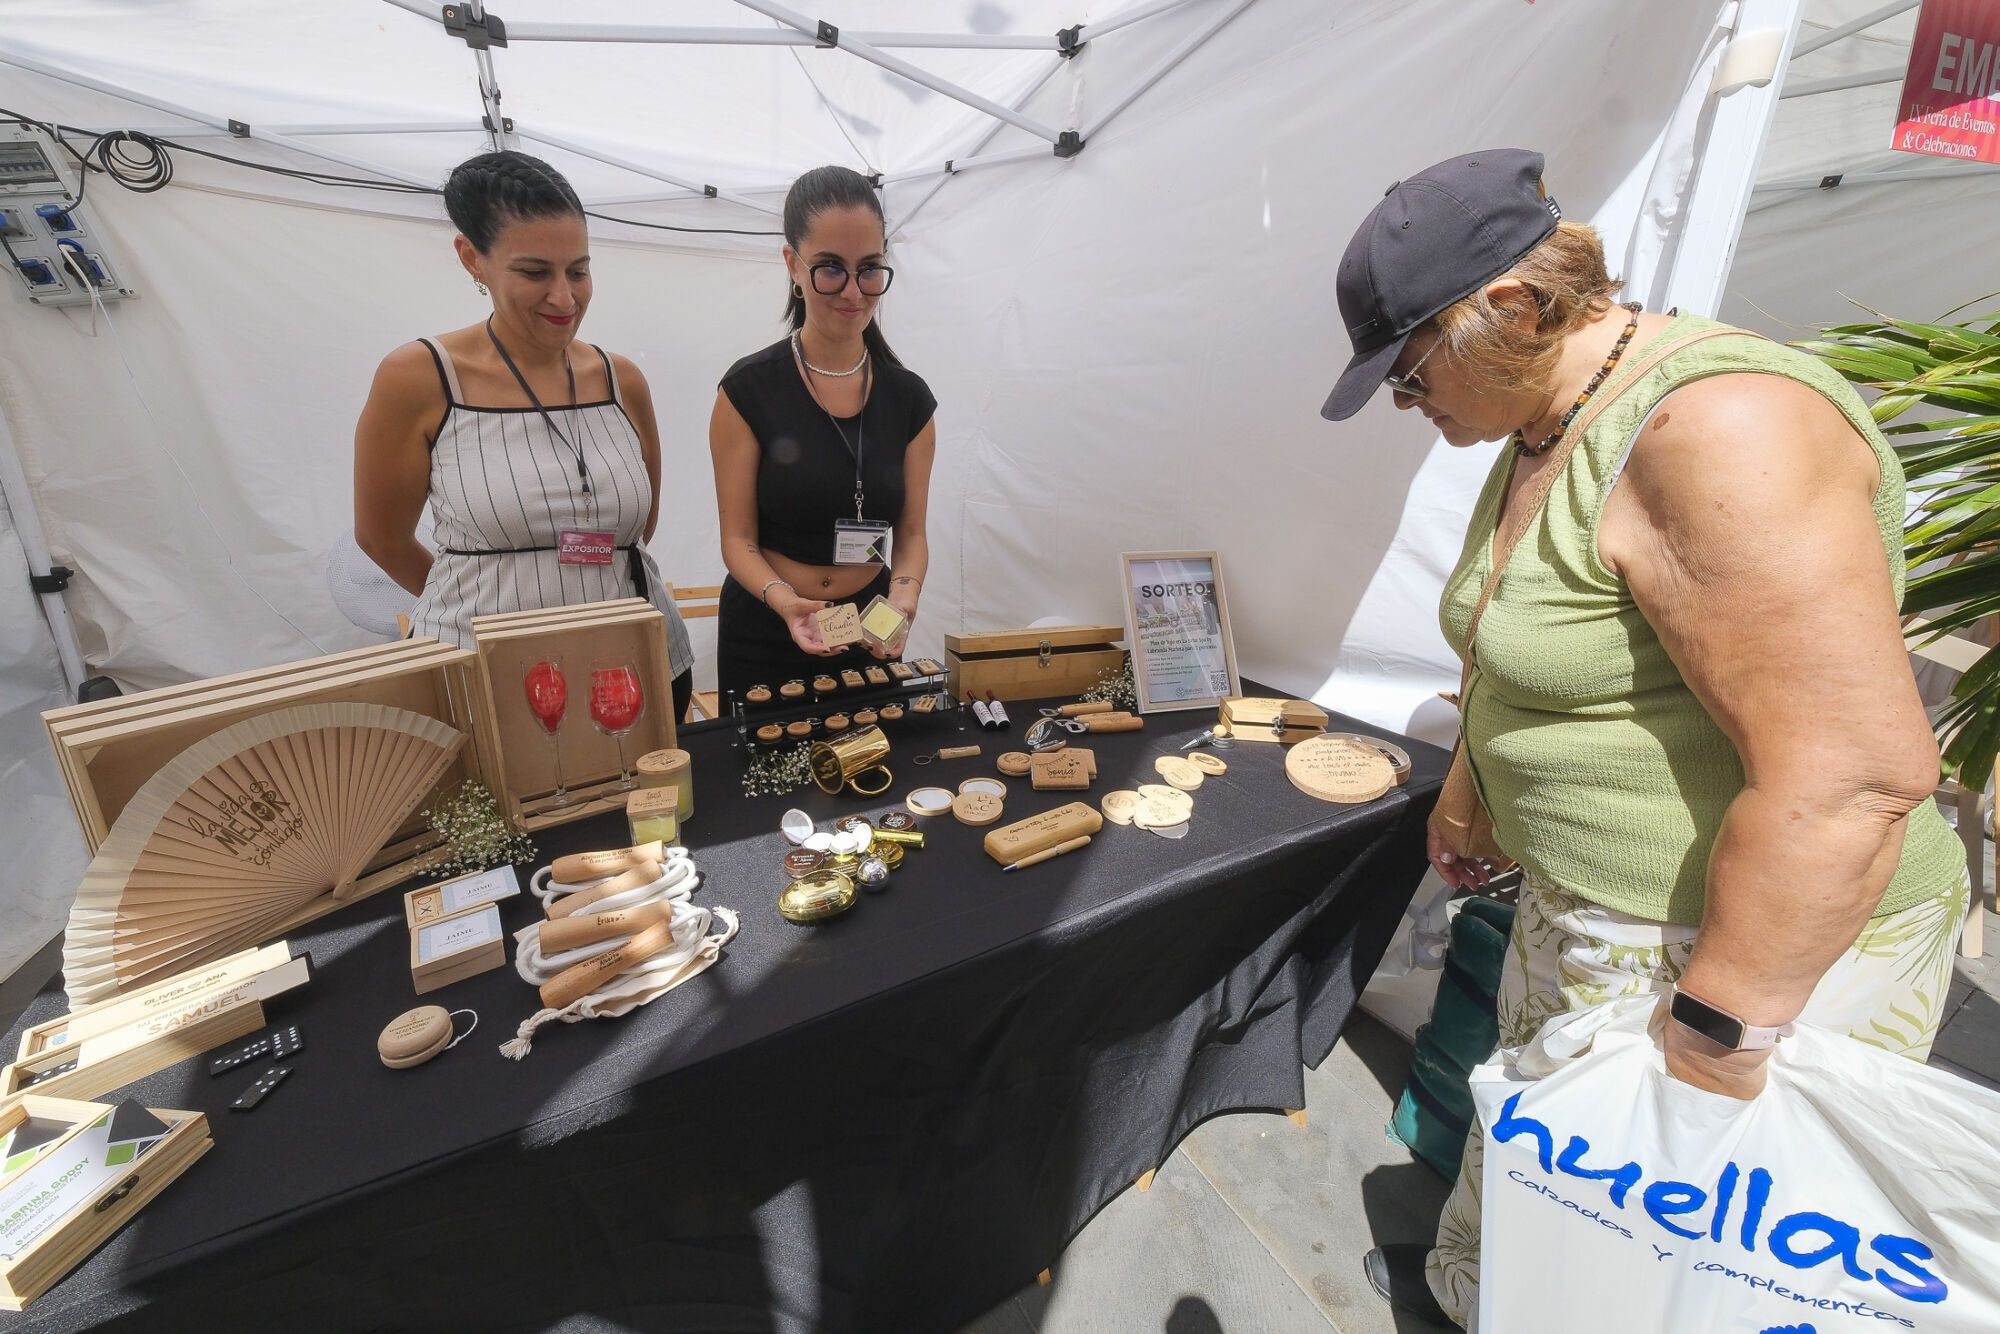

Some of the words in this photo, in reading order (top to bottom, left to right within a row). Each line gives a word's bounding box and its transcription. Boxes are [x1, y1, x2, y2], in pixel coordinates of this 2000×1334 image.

[1924, 106, 1948, 127] Feria
[1949, 111, 1961, 129] de
[1962, 112, 1996, 135] Eventos
[1903, 131, 1915, 149] &
[1915, 132, 1978, 158] Celebraciones
[562, 545, 612, 554] EXPOSITOR
[1047, 767, 1076, 776] Sonia
[214, 790, 291, 856] MEJOR
[220, 795, 253, 822] vida
[254, 815, 303, 866] contigo
[467, 883, 493, 894] JAIME
[447, 928, 474, 940] JAIME
[597, 915, 615, 926] Erika
[144, 987, 185, 1005] OLIVER
[204, 972, 228, 983] ANA
[147, 993, 248, 1036] SAMUEL
[50, 1157, 89, 1190] GODOY
[1491, 1090, 1948, 1305] huellas
[1508, 1170, 1634, 1239] calzados
[1693, 1261, 1916, 1329] complementos
